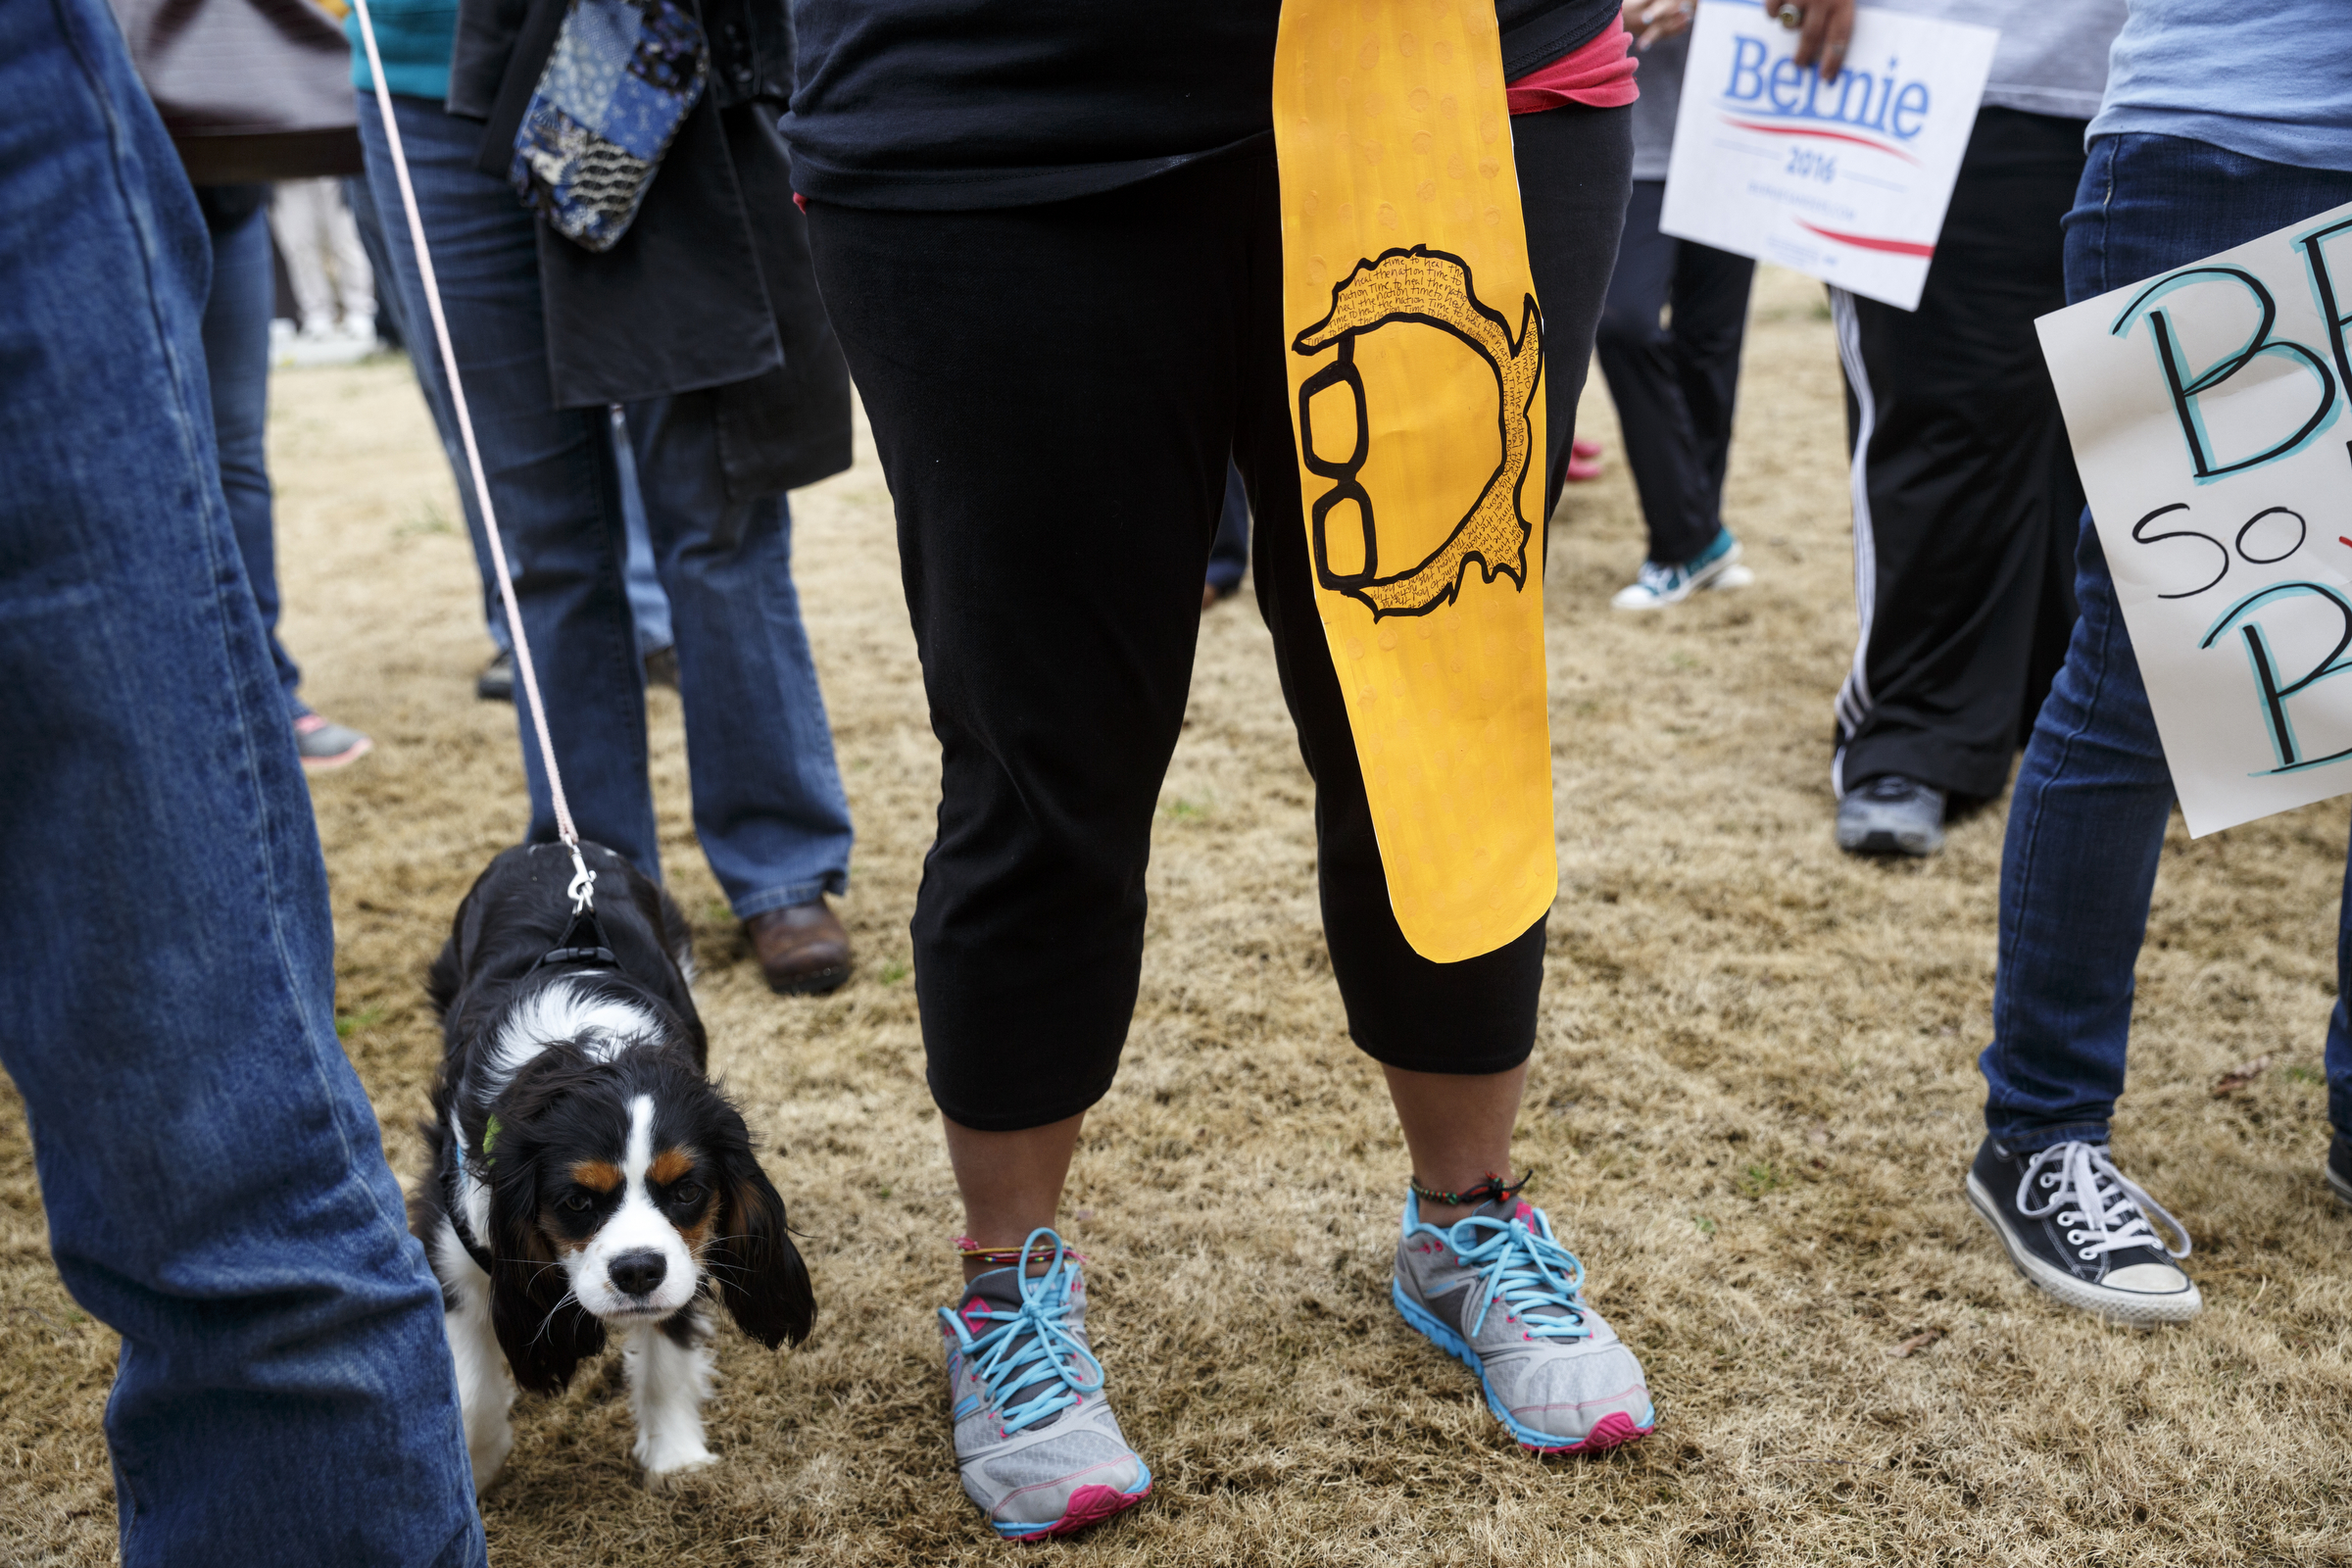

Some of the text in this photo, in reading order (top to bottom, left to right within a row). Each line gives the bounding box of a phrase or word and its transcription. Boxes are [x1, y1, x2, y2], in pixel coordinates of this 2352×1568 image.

[1723, 33, 1931, 141] Bernie
[1785, 146, 1838, 184] 2016
[1410, 256, 1419, 265] to
[1424, 258, 1443, 269] heal
[1448, 265, 1463, 278] the
[1339, 287, 1368, 302] nation
[1405, 273, 1423, 285] heal
[1354, 272, 1372, 286] heal
[1450, 274, 1462, 286] to
[1337, 301, 1354, 314] heal
[1358, 296, 1376, 307] the
[1378, 299, 1393, 309] the
[1396, 295, 1424, 306] nation
